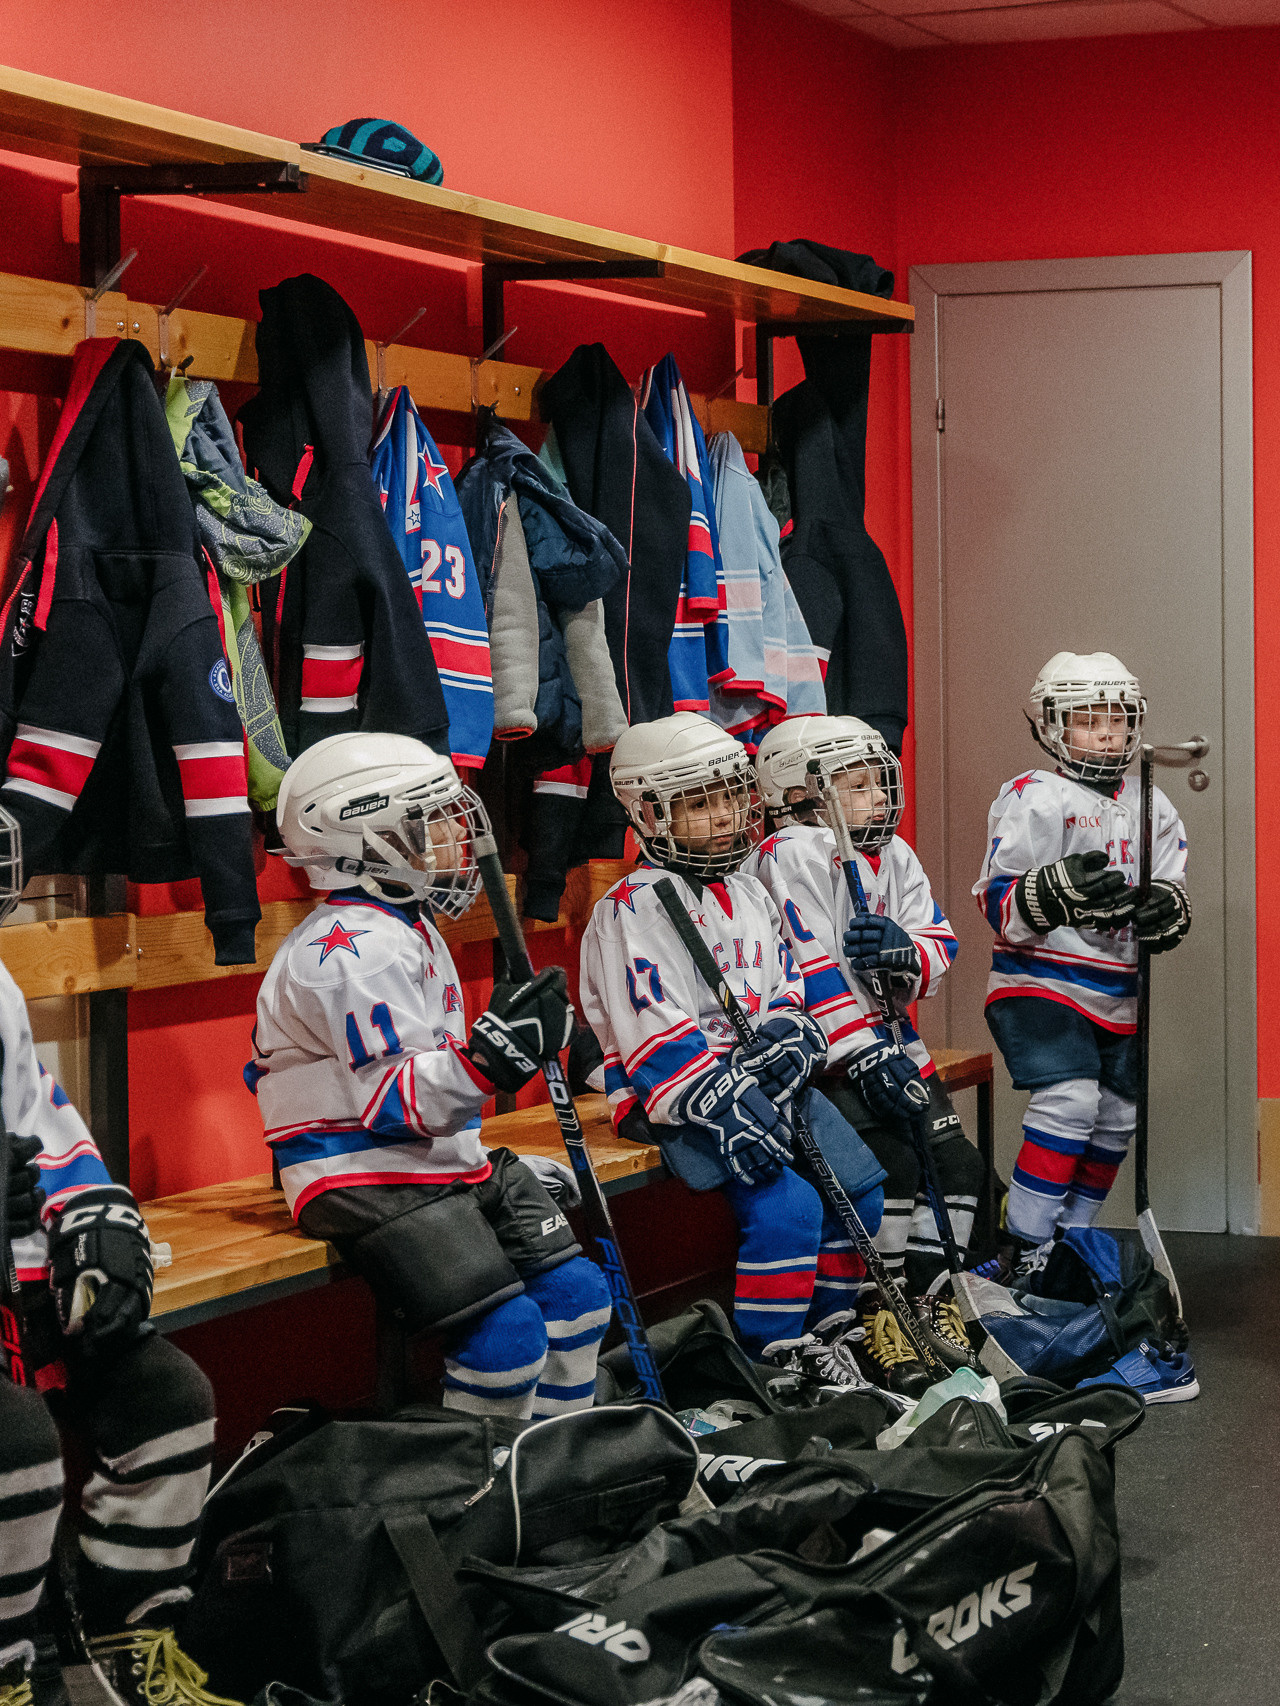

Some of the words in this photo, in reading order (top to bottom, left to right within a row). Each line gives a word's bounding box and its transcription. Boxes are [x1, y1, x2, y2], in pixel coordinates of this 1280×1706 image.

[421, 539, 466, 600] 23
[707, 751, 740, 767] BAUER
[342, 798, 387, 818] BAUER
[346, 1001, 404, 1073] 11
[932, 1114, 960, 1131] CC
[595, 1237, 662, 1400] FISCHER
